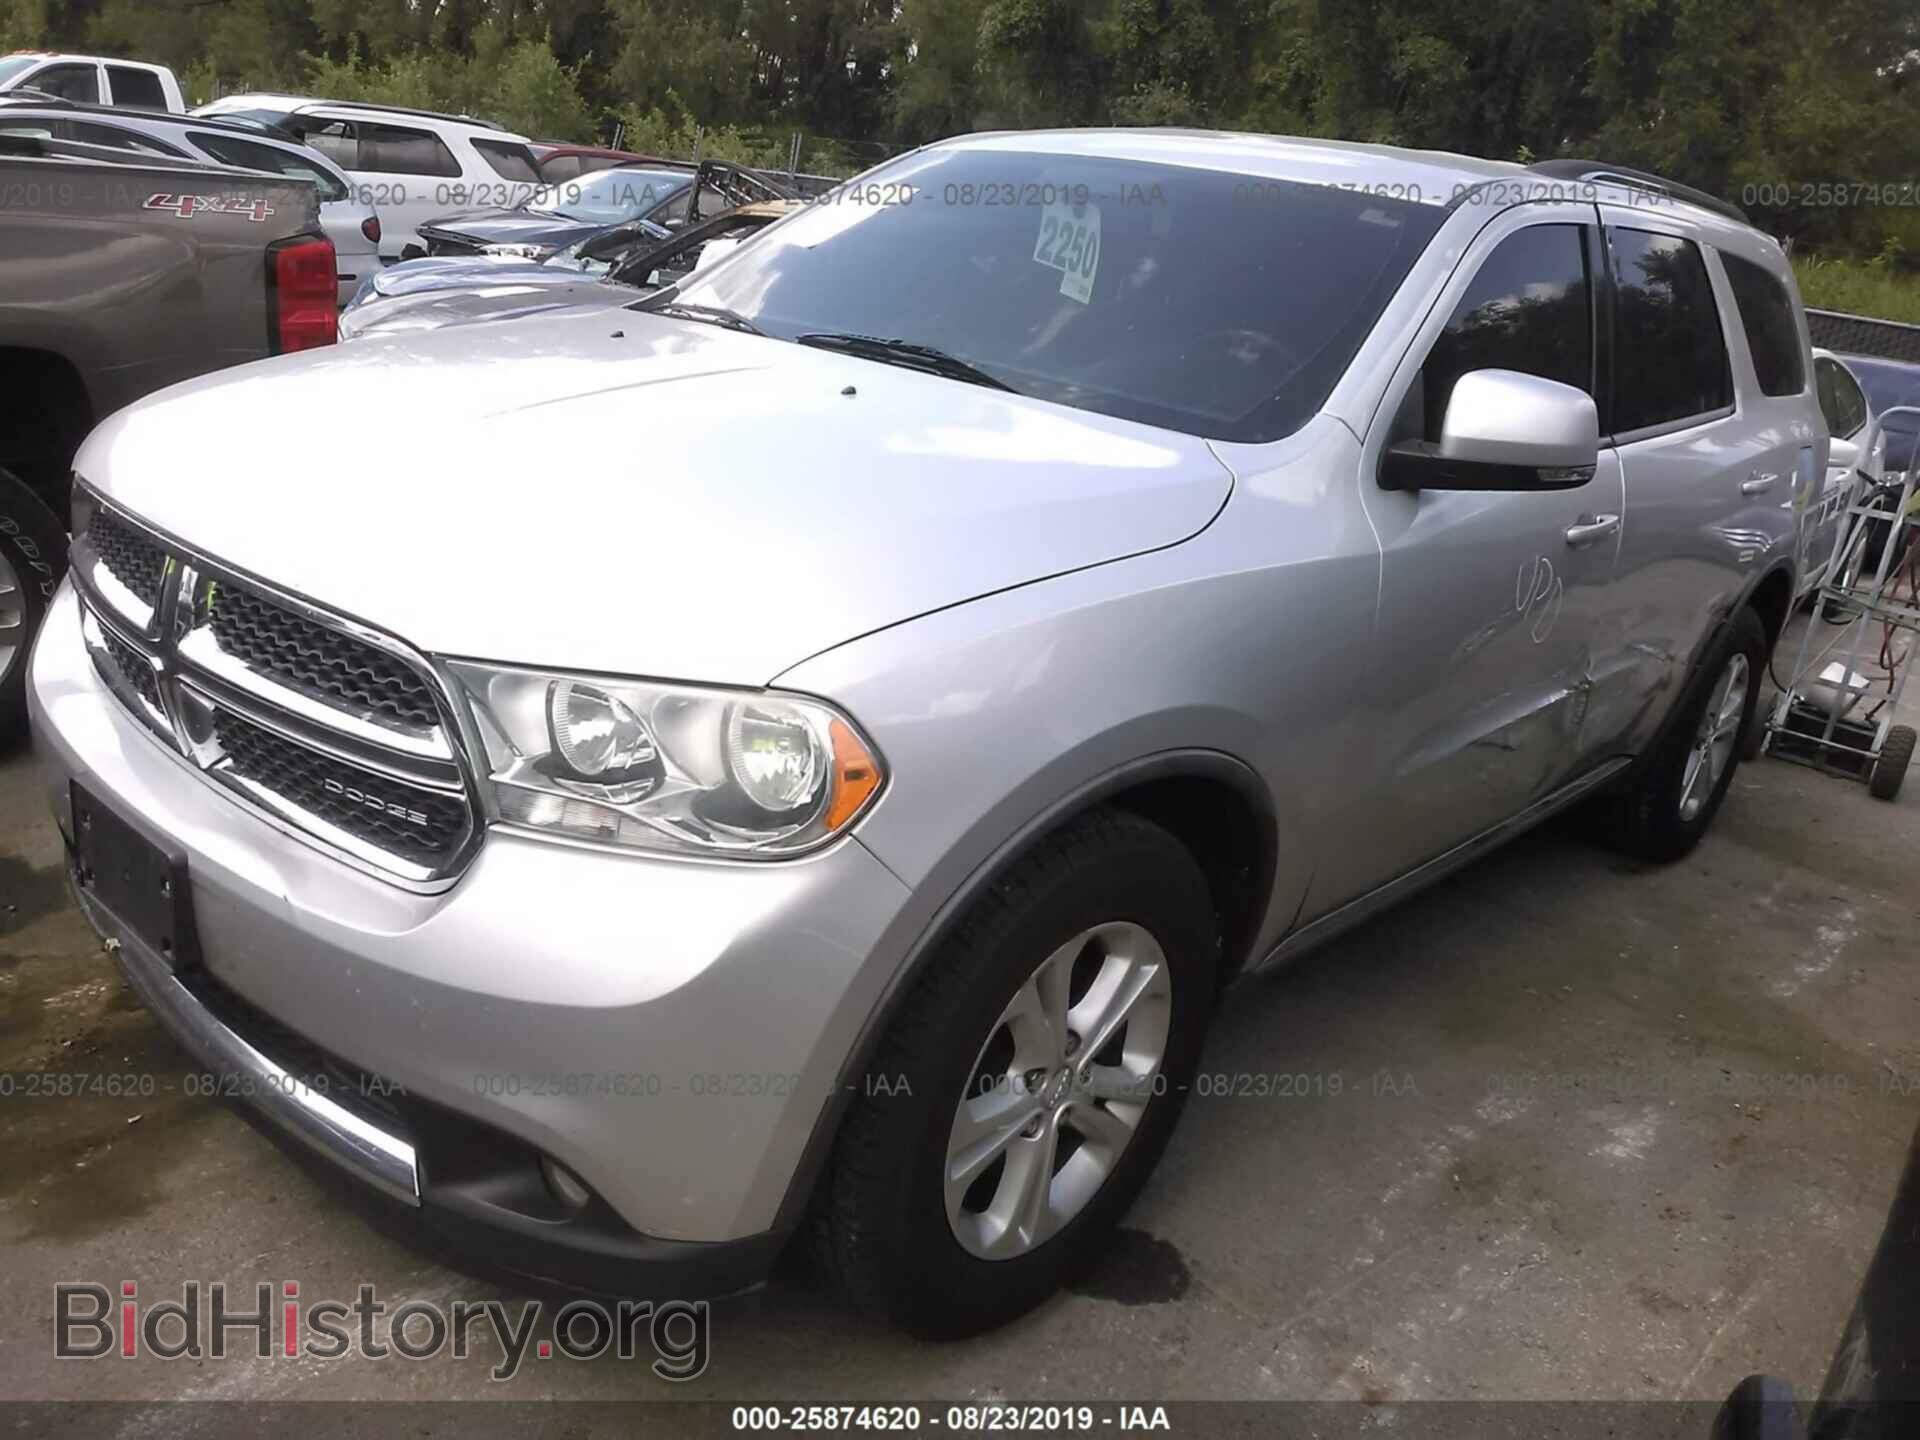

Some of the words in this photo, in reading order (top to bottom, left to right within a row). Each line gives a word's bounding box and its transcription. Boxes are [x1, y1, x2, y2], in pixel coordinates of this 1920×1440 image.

[142, 193, 275, 222] 4x4
[1037, 217, 1098, 278] 2250
[324, 778, 428, 826] DODGE
